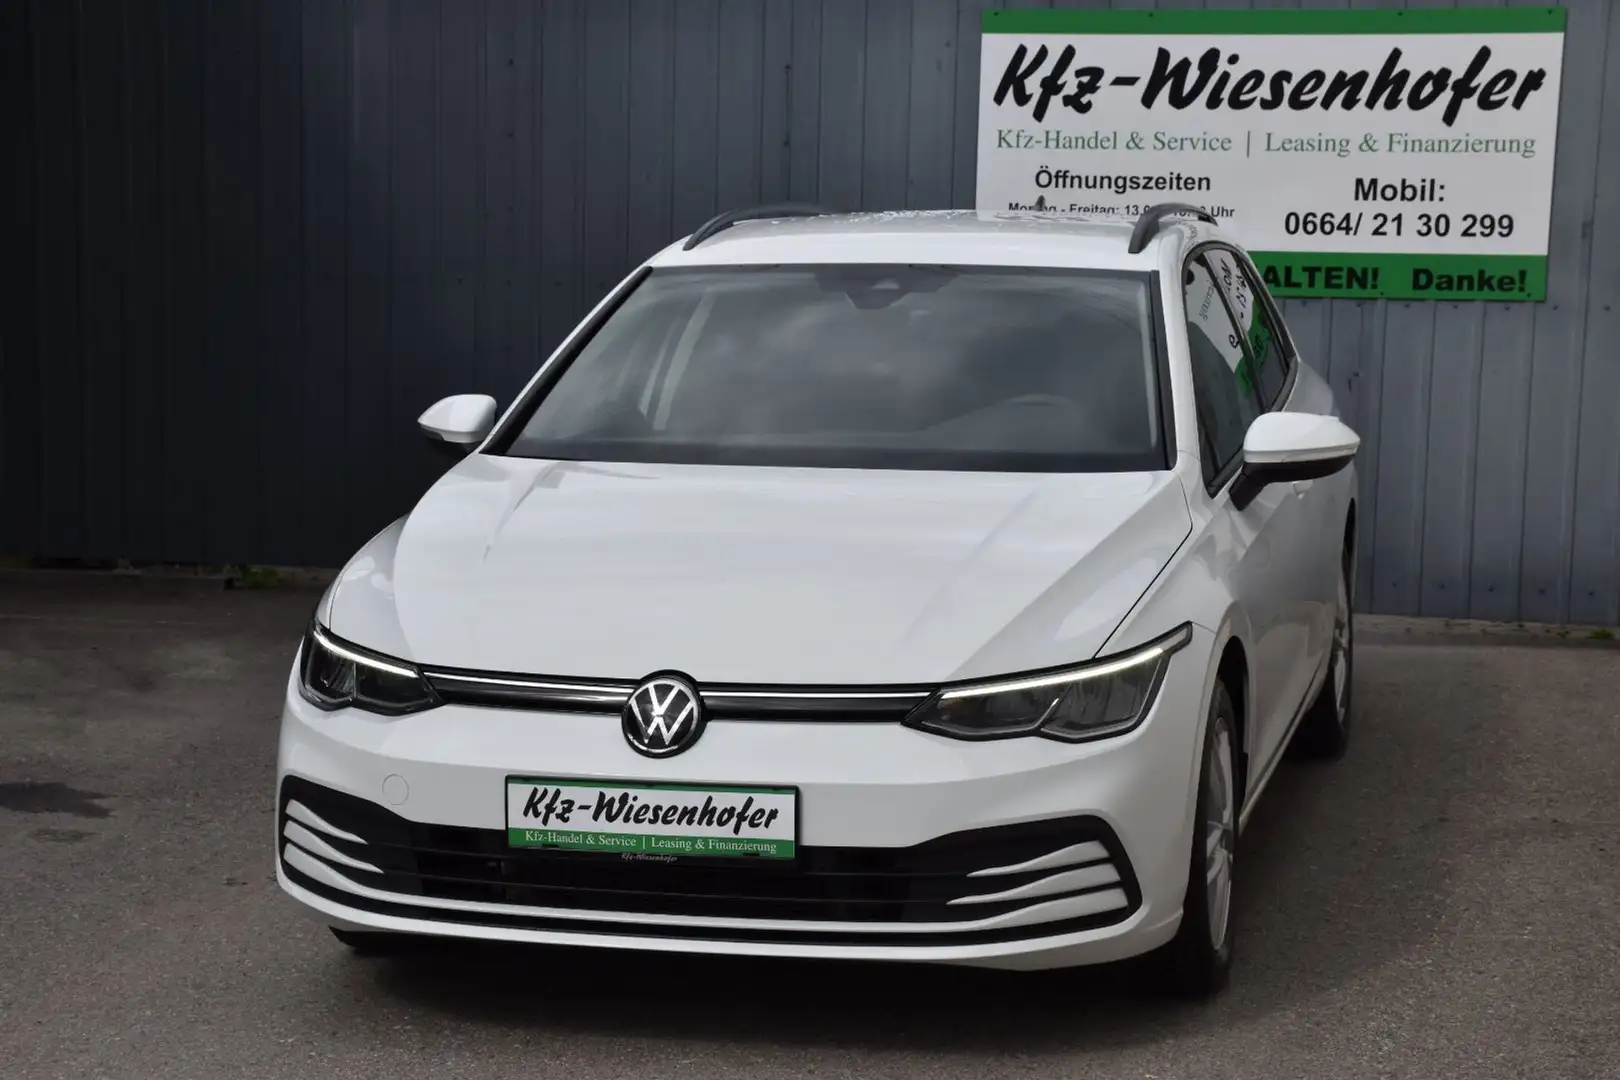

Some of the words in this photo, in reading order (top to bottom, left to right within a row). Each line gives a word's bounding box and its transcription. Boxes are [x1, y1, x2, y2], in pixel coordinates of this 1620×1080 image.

[993, 44, 1546, 127] Kfz-Wiesenhofer
[997, 129, 1118, 150] Kfz-Handel
[1126, 132, 1145, 151] &
[1153, 132, 1232, 151] Service
[1265, 132, 1350, 158] Leasing
[1358, 133, 1380, 153] &
[1388, 133, 1536, 158] Finanzierung
[1035, 166, 1211, 194] Öffnungszeiten
[1354, 178, 1446, 202] Mobil:
[1211, 206, 1235, 217] Uhr
[1284, 212, 1363, 236] 0664/
[1371, 213, 1403, 236] 21
[1416, 214, 1451, 237] 30
[1461, 214, 1514, 238] 299
[1412, 268, 1527, 292] Danke!
[523, 787, 778, 835] Kfz-Wiesenhofer
[525, 830, 583, 844] Kfz-Handel
[586, 835, 596, 847] &
[599, 835, 637, 847] Service
[652, 837, 692, 851] Leasing
[695, 839, 705, 850] &
[708, 839, 777, 854] Finanzierung
